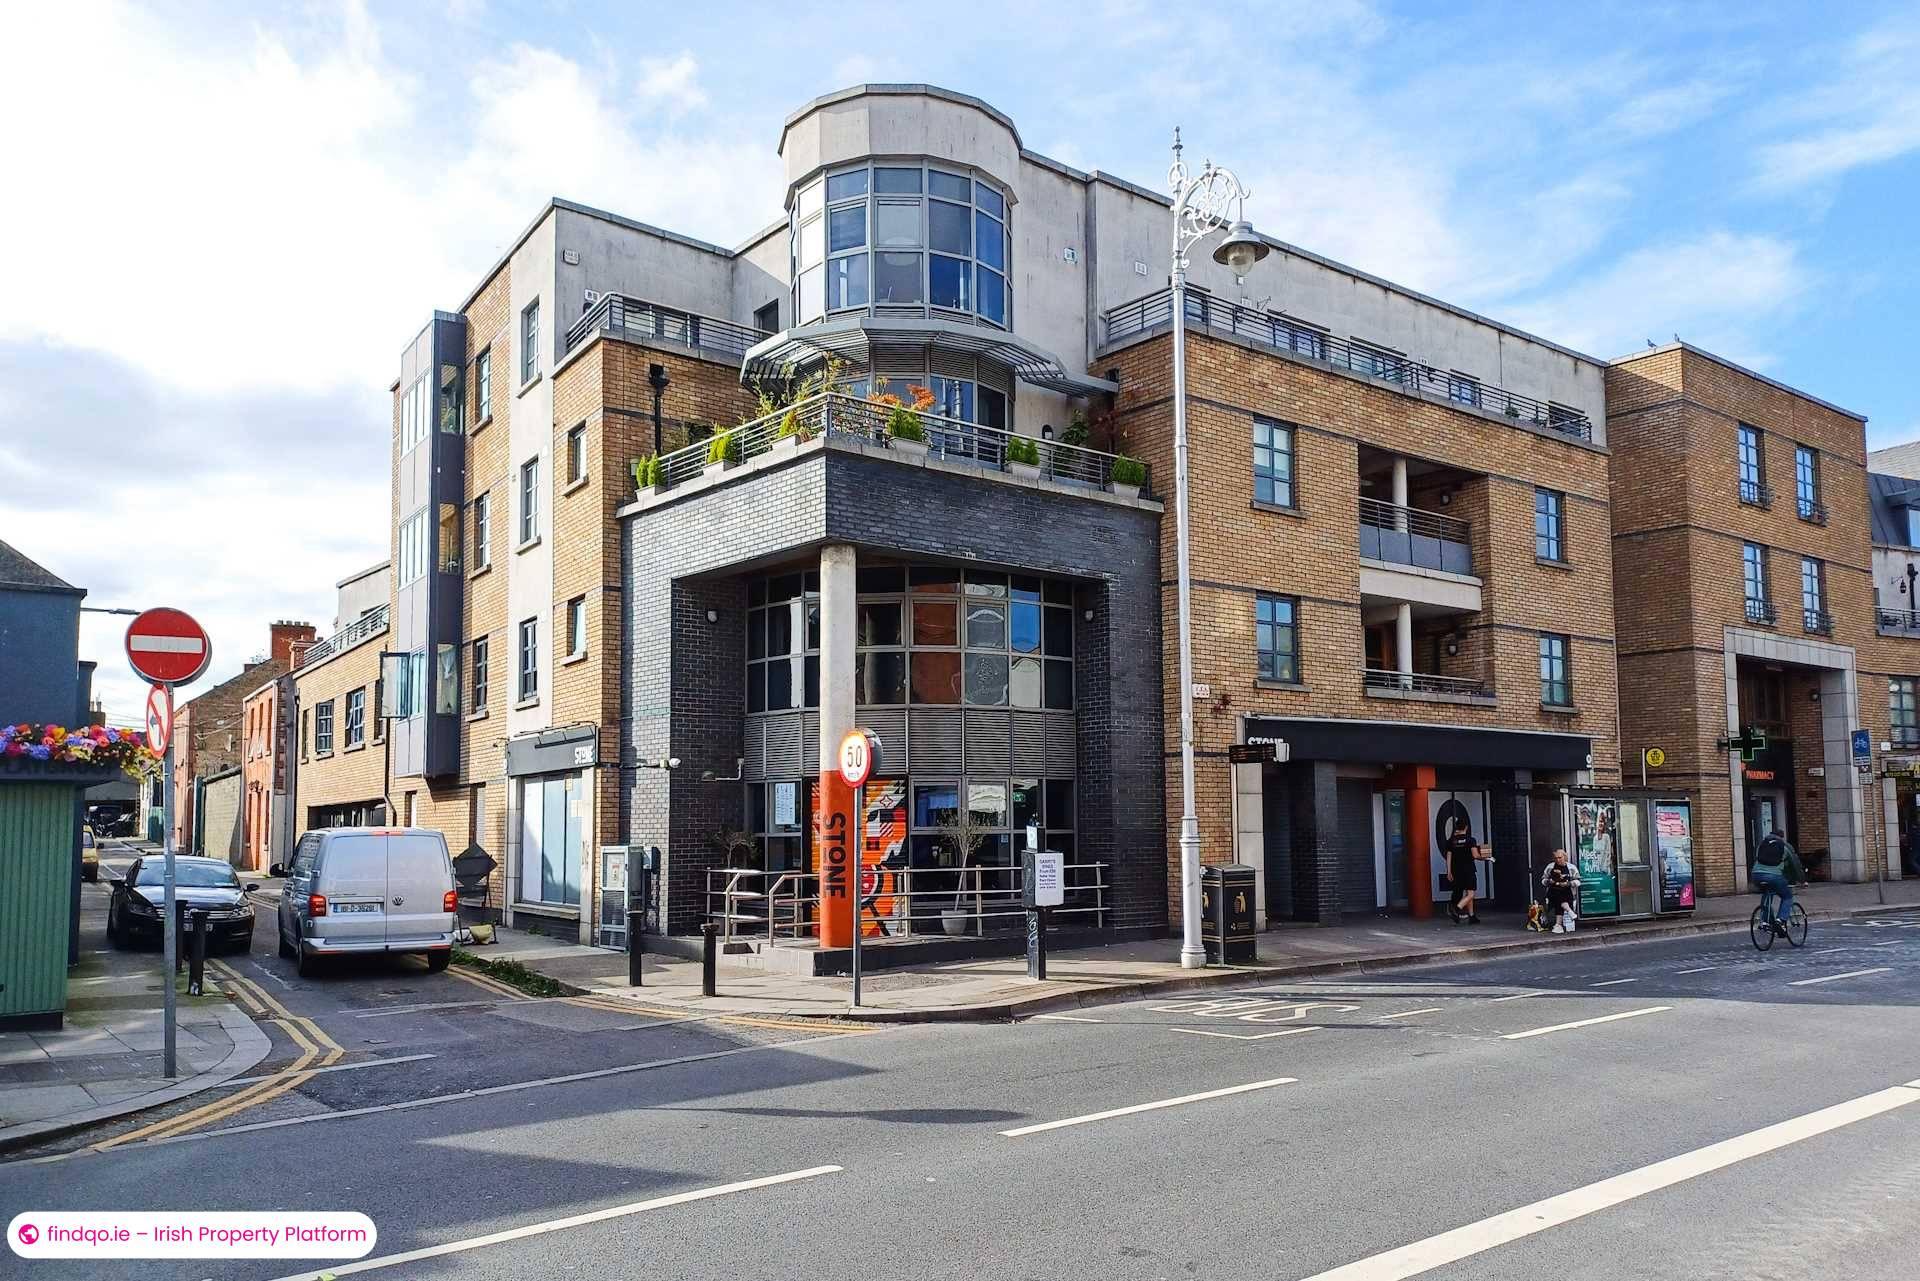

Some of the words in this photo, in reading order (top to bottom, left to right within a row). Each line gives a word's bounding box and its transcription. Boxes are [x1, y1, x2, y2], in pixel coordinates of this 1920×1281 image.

[574, 745, 594, 765] STONE
[847, 745, 863, 768] 50
[1745, 769, 1775, 780] PHARMACY
[822, 812, 847, 898] STONE
[1145, 996, 1361, 1023] BUS
